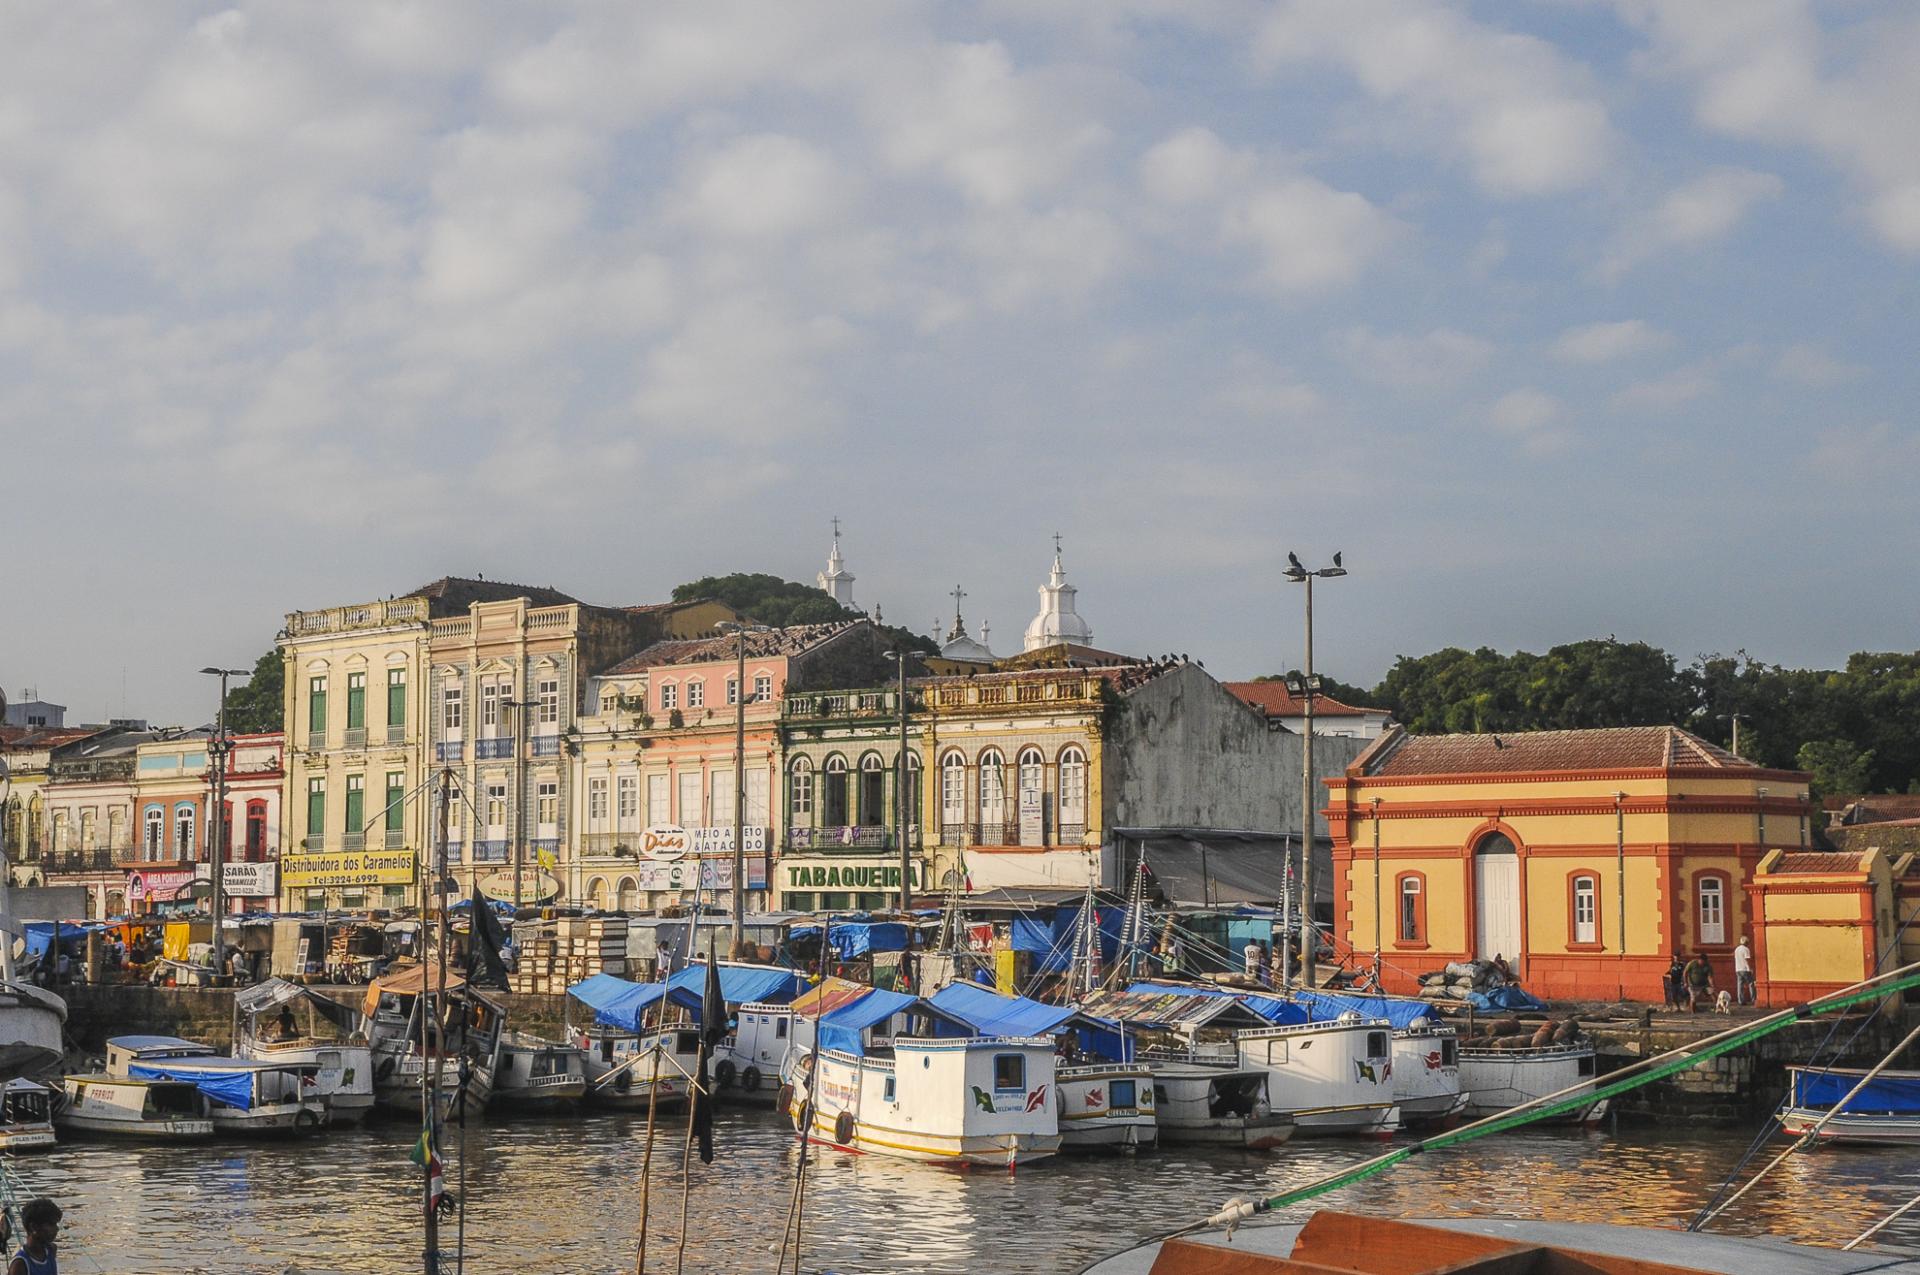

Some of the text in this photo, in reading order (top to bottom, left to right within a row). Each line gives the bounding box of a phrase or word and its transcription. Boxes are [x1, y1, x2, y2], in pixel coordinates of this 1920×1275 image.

[703, 839, 762, 851] ATACDO
[283, 854, 411, 873] Distribuidora dos Caramelos
[787, 866, 919, 887] TABAQUEIRA
